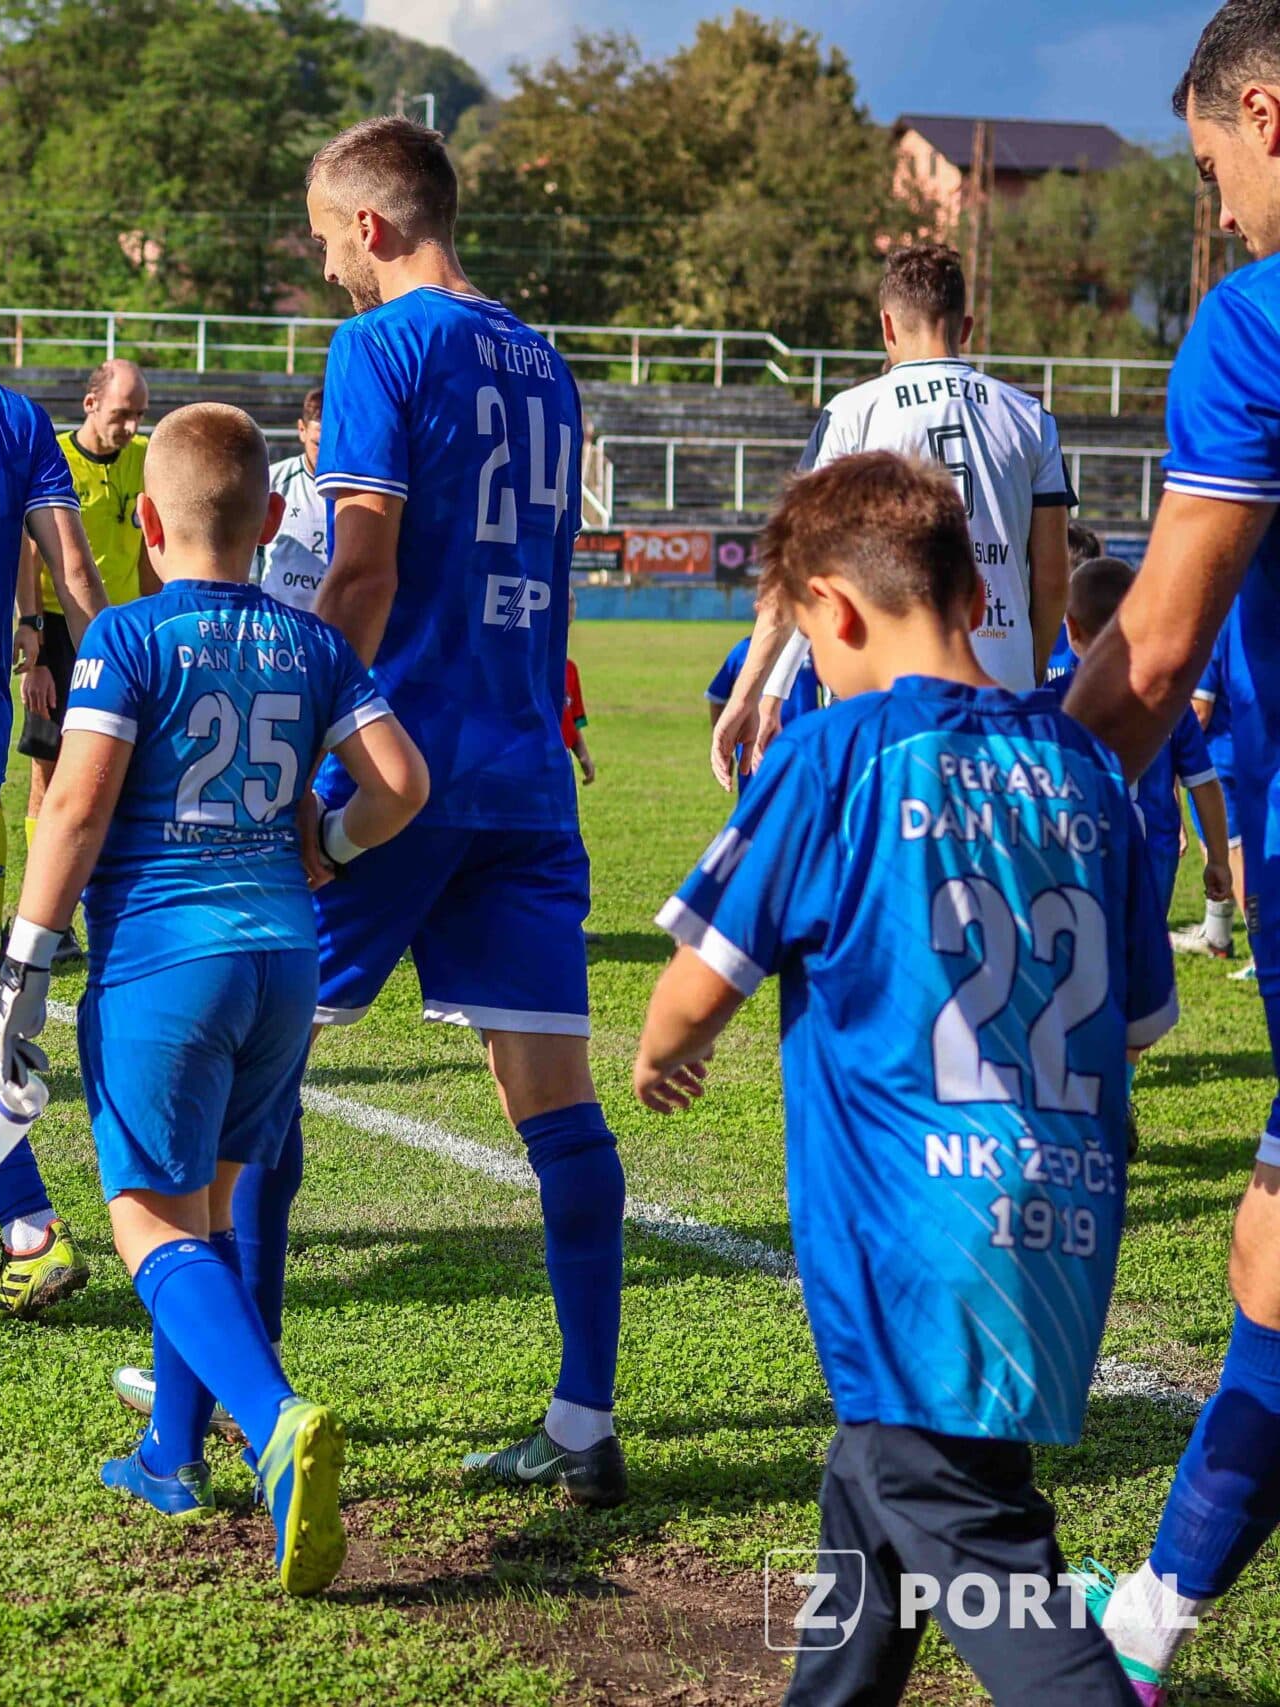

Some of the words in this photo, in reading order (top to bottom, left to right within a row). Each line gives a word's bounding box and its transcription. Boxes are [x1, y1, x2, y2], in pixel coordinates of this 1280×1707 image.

[500, 336, 556, 382] ŽEPČE
[894, 377, 989, 409] ALPEZA
[475, 385, 571, 545] 24
[927, 423, 975, 522] 5
[312, 531, 328, 555] 2
[483, 574, 551, 632] EP
[198, 620, 286, 642] PEKARA
[177, 645, 231, 672] DAN
[238, 647, 248, 671] I
[174, 690, 303, 826] 25
[939, 753, 1084, 800] PEKARA
[163, 821, 203, 844] NK
[901, 799, 994, 841] DAN
[1008, 807, 1019, 845] I
[931, 875, 1111, 1117] 22
[924, 1133, 1004, 1181] NK
[989, 1195, 1097, 1258] 1919
